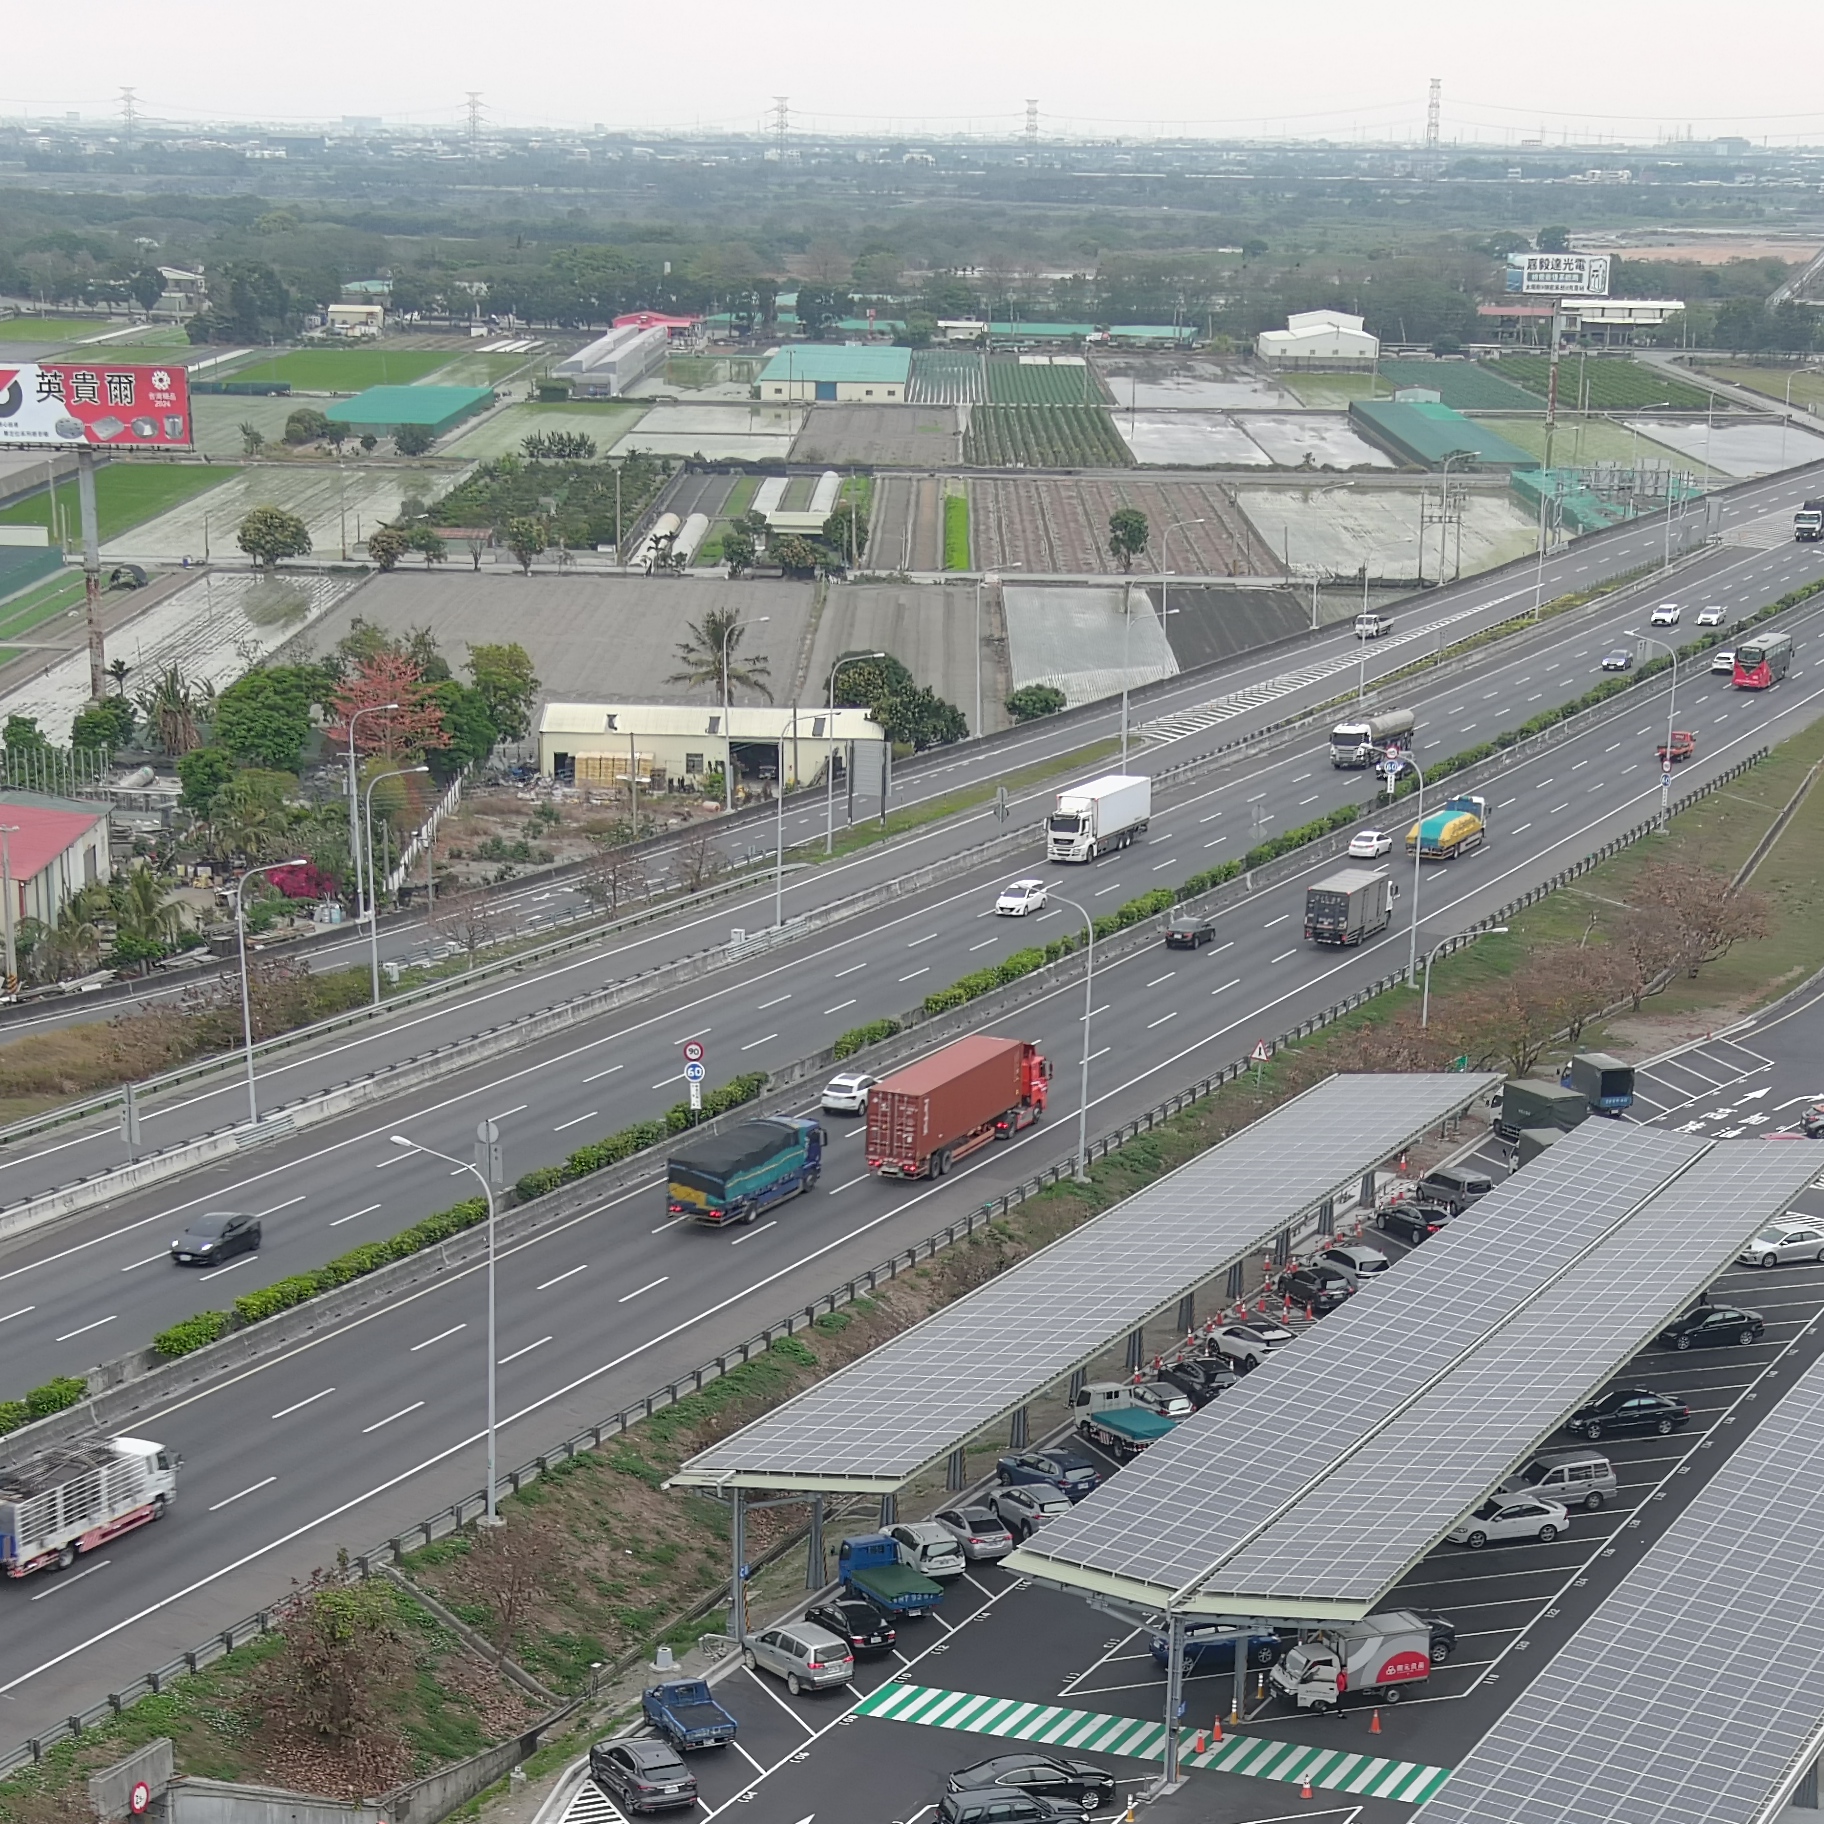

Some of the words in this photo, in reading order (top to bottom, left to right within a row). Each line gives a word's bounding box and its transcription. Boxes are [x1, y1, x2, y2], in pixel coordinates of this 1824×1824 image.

[36, 371, 135, 407] 英貴爾
[688, 1047, 699, 1055] 90
[687, 1067, 702, 1077] 60
